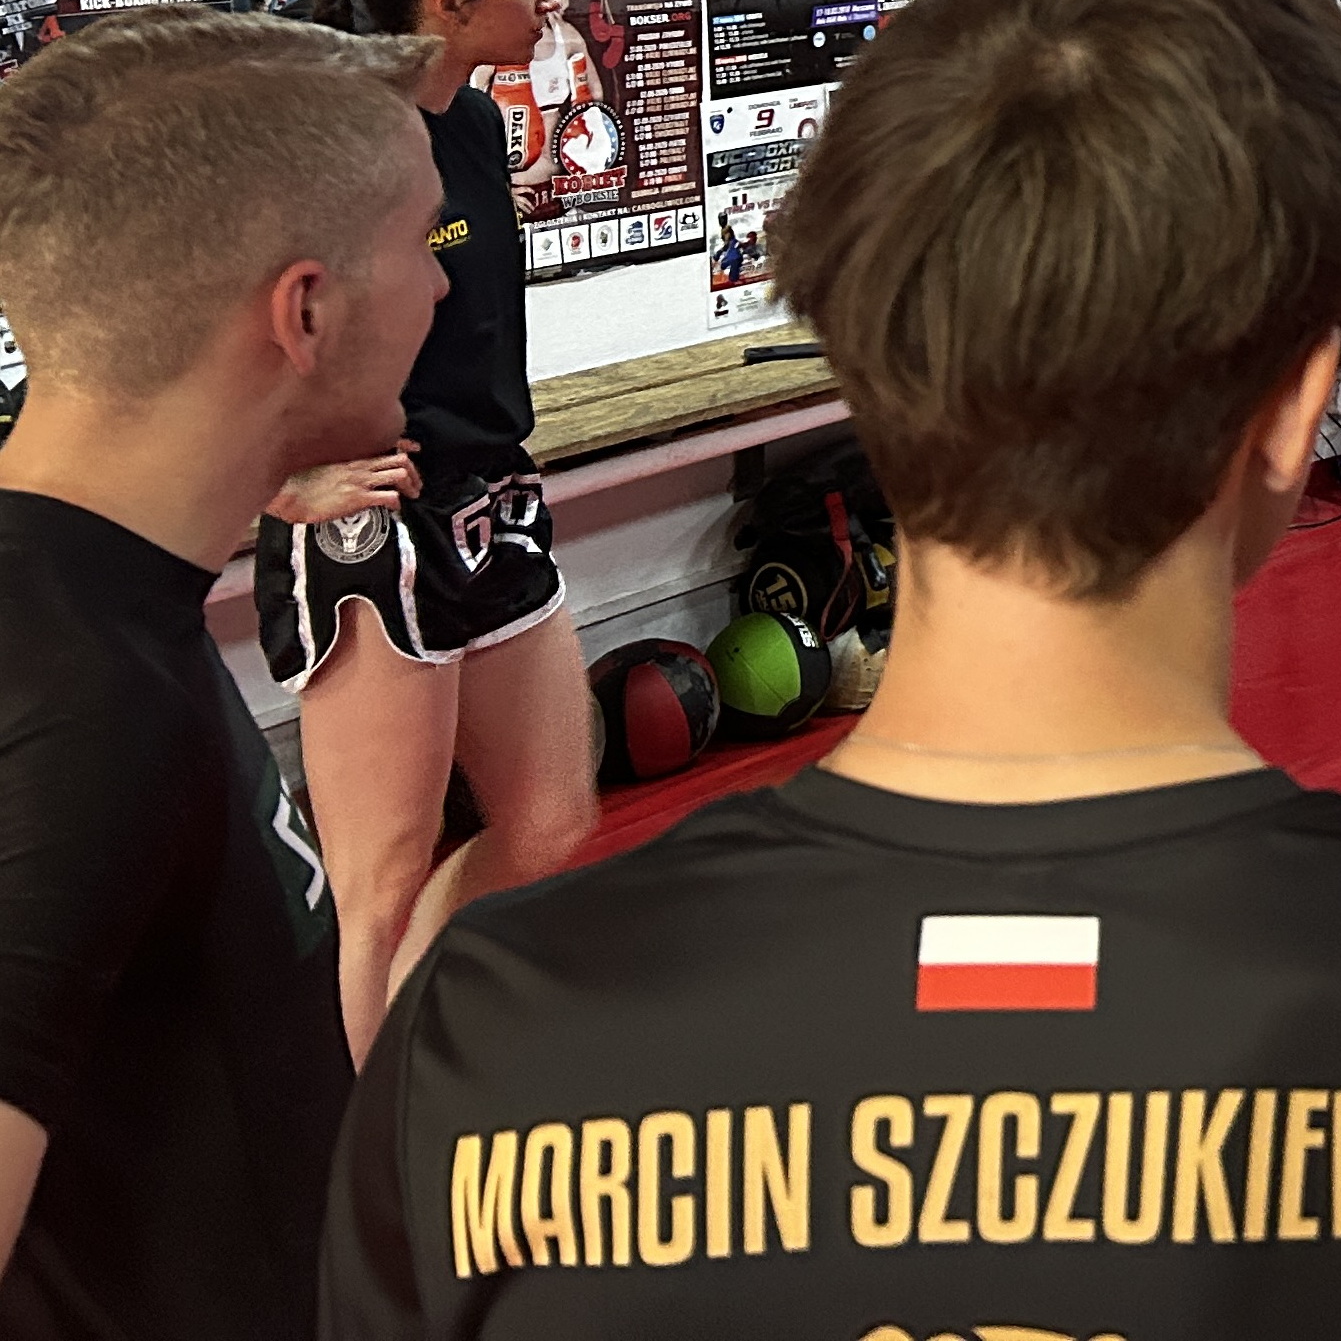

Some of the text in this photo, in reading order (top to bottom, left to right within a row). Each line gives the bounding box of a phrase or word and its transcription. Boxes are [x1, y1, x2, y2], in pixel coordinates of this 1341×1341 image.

[37, 14, 67, 44] 4
[753, 108, 775, 130] 9
[551, 165, 629, 196] KOBIET
[765, 573, 798, 613] 15
[450, 1102, 812, 1279] MARCIN
